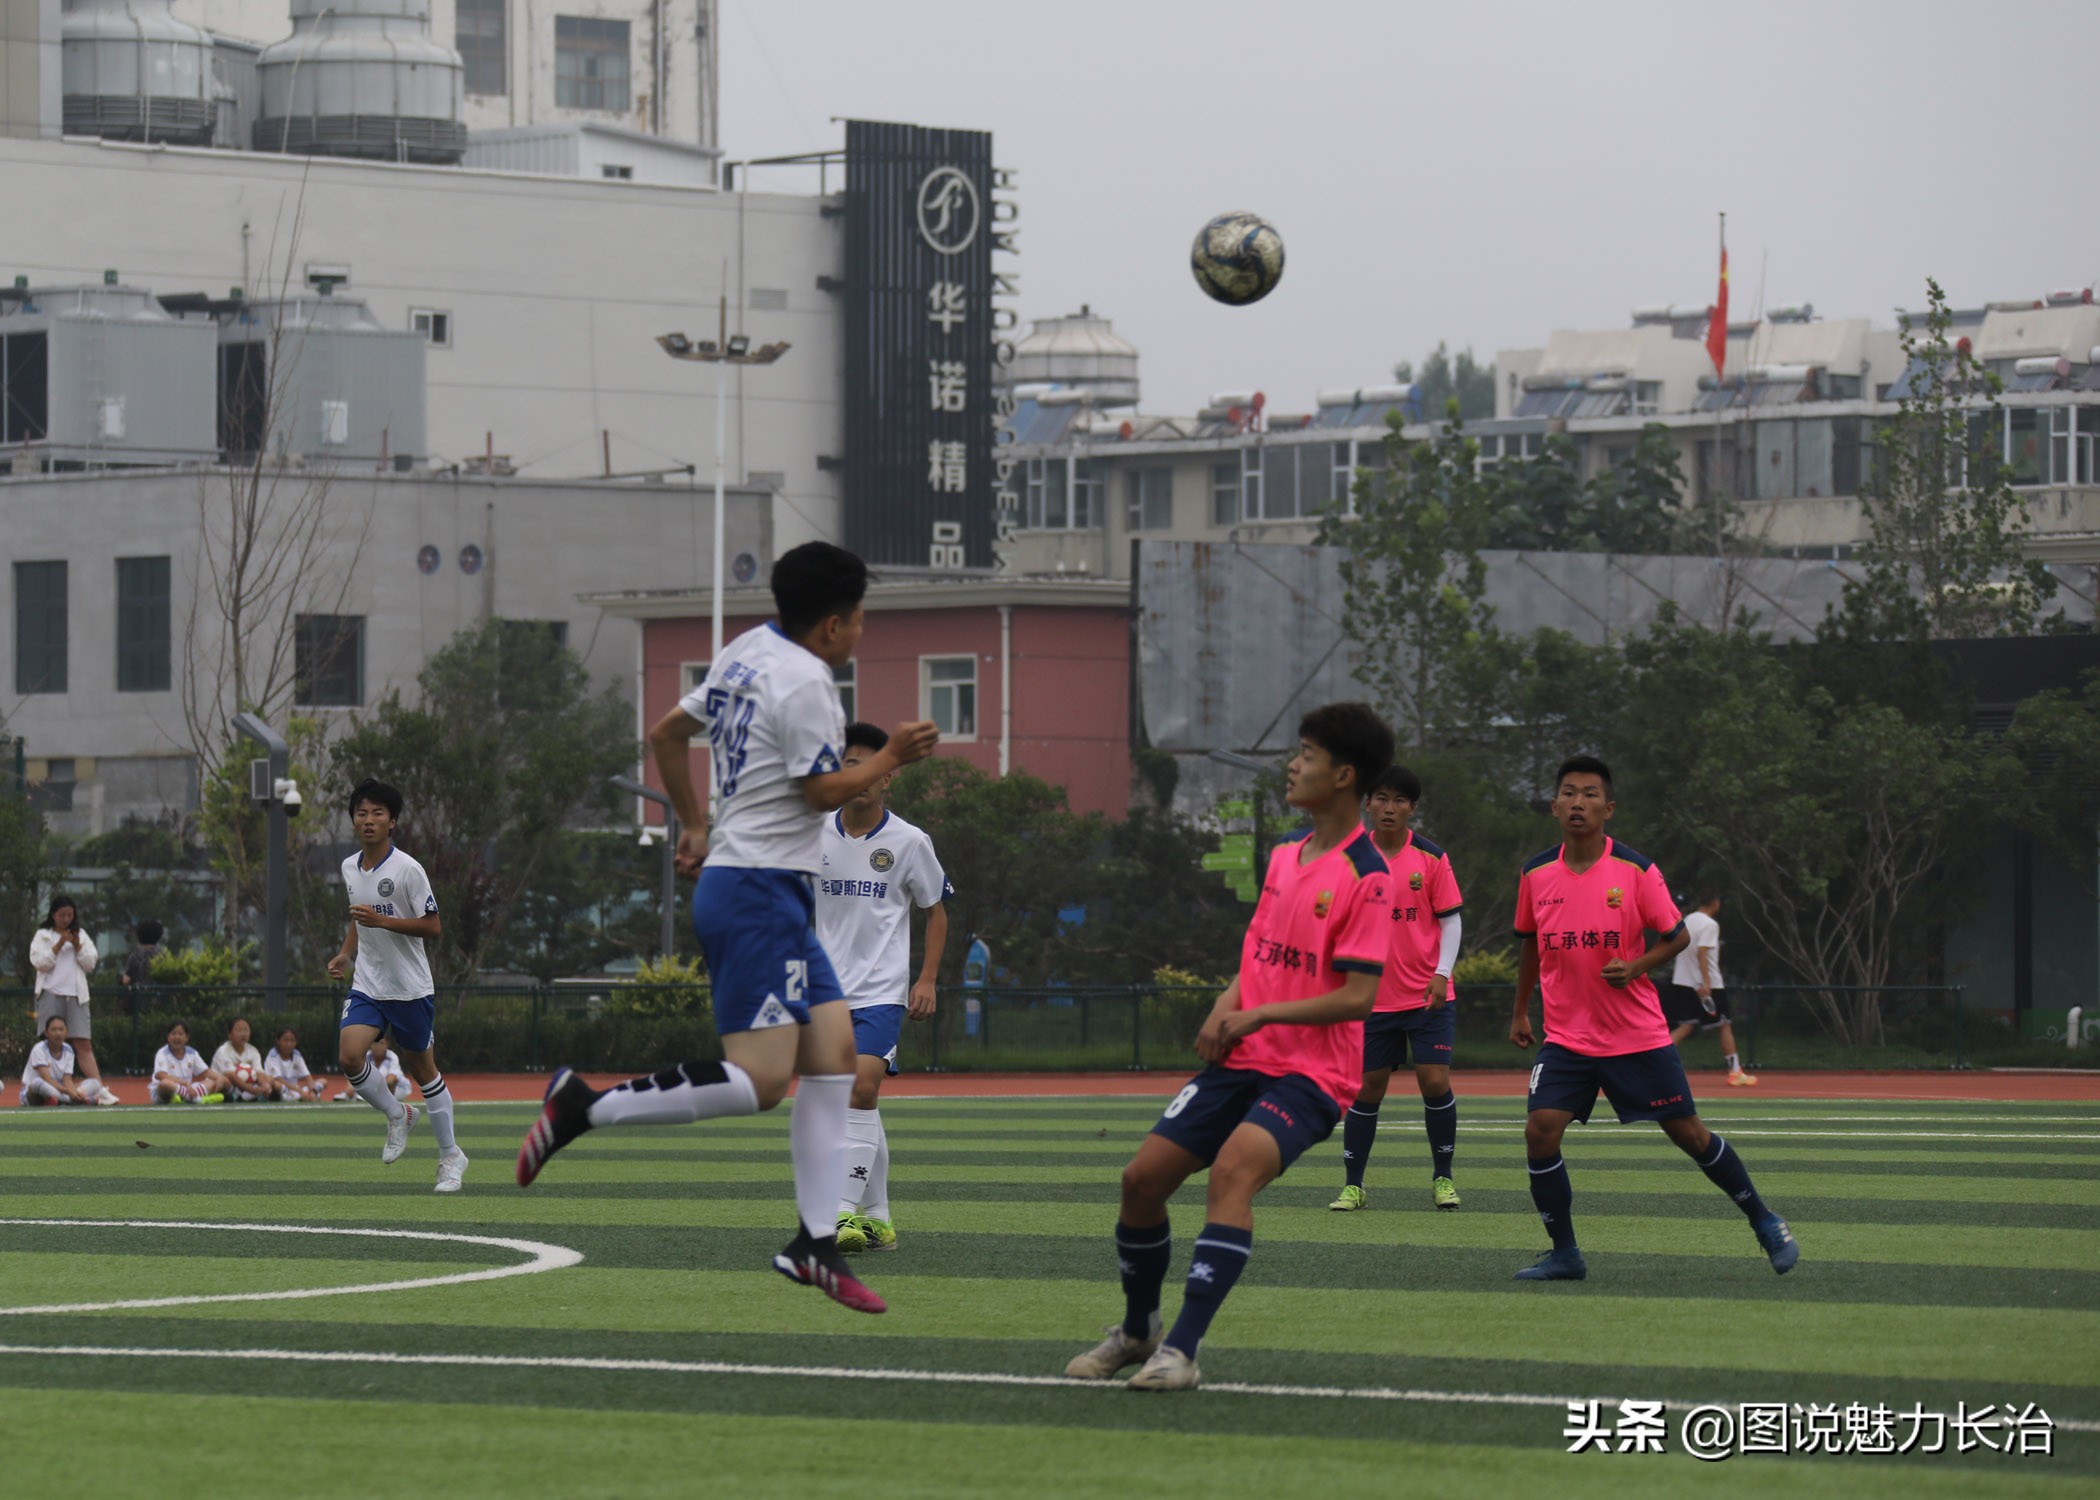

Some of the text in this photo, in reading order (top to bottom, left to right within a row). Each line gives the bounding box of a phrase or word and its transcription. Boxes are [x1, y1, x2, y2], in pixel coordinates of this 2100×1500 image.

[927, 281, 967, 569] 华诺精品
[1538, 897, 1565, 906] KELME
[1542, 930, 1621, 950] 汇承体育
[1163, 1083, 1199, 1119] 8
[1650, 1094, 1683, 1107] KELME
